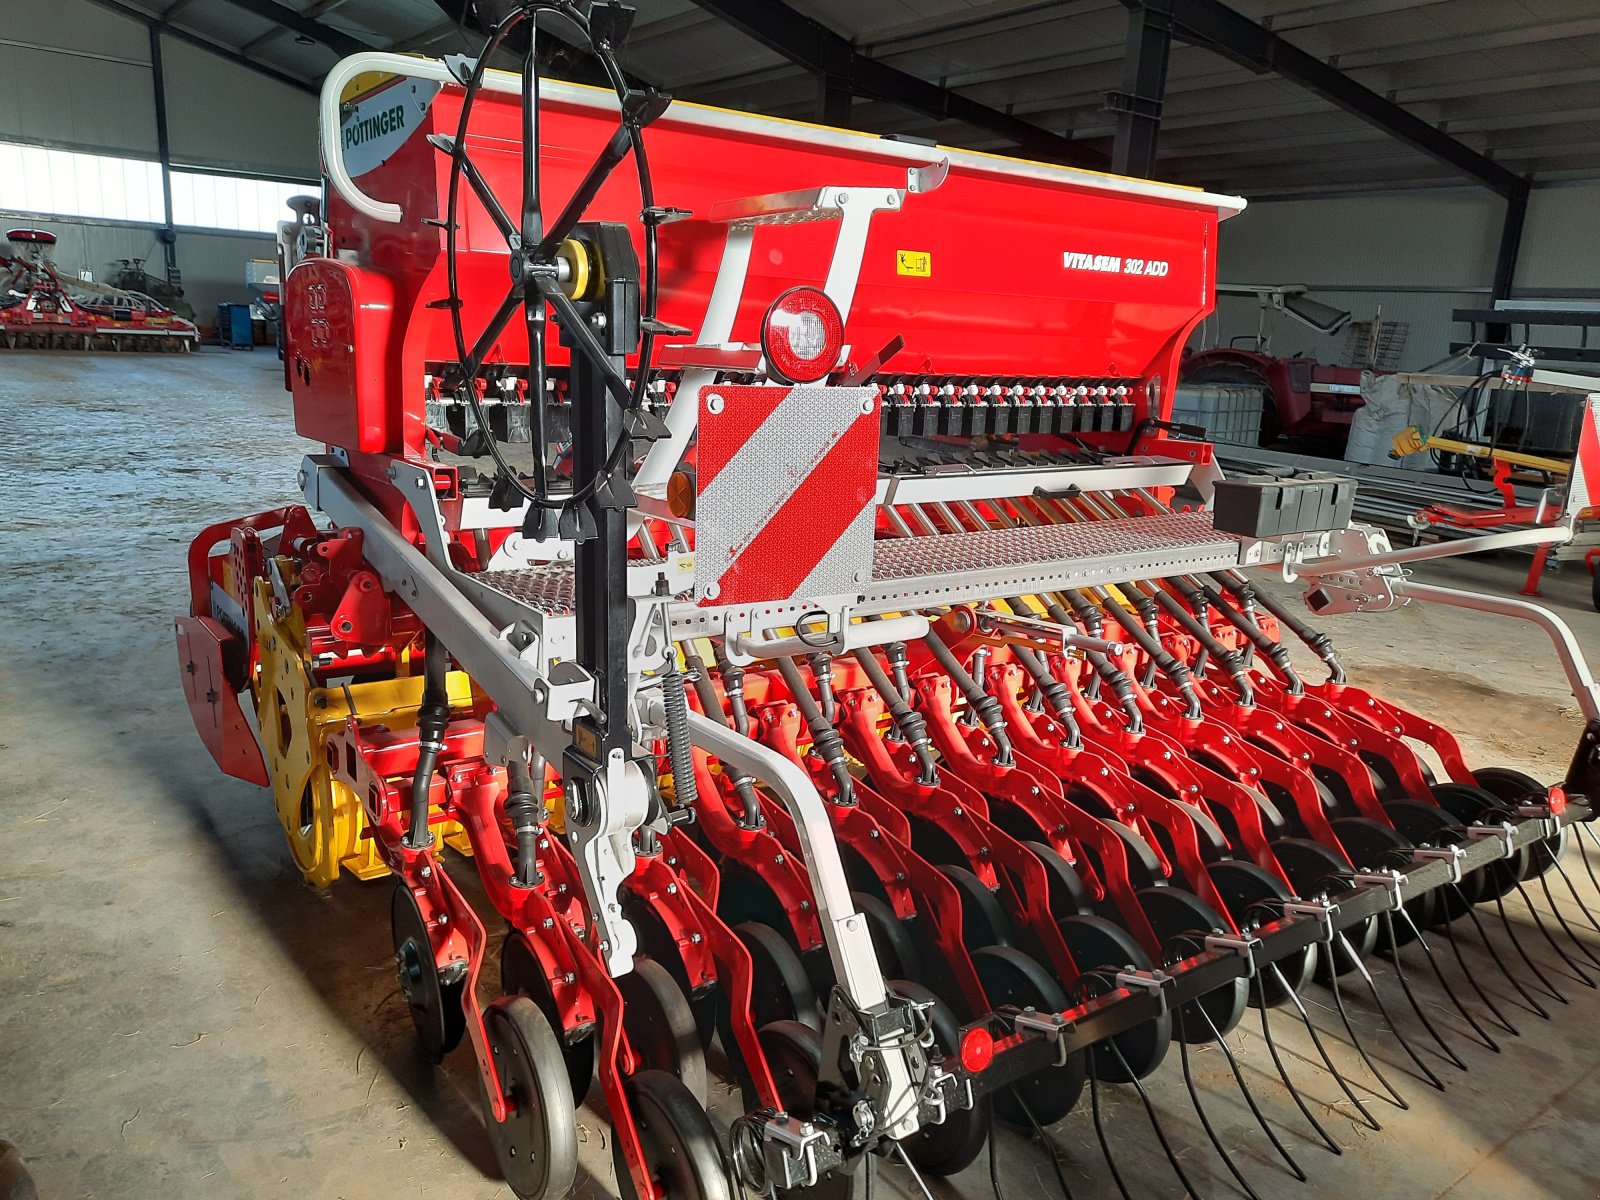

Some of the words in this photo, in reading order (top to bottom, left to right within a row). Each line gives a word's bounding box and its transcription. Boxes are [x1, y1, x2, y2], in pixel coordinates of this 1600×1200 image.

[1063, 251, 1122, 273] VITASEM
[1123, 258, 1144, 275] 302
[1143, 260, 1169, 277] ADD
